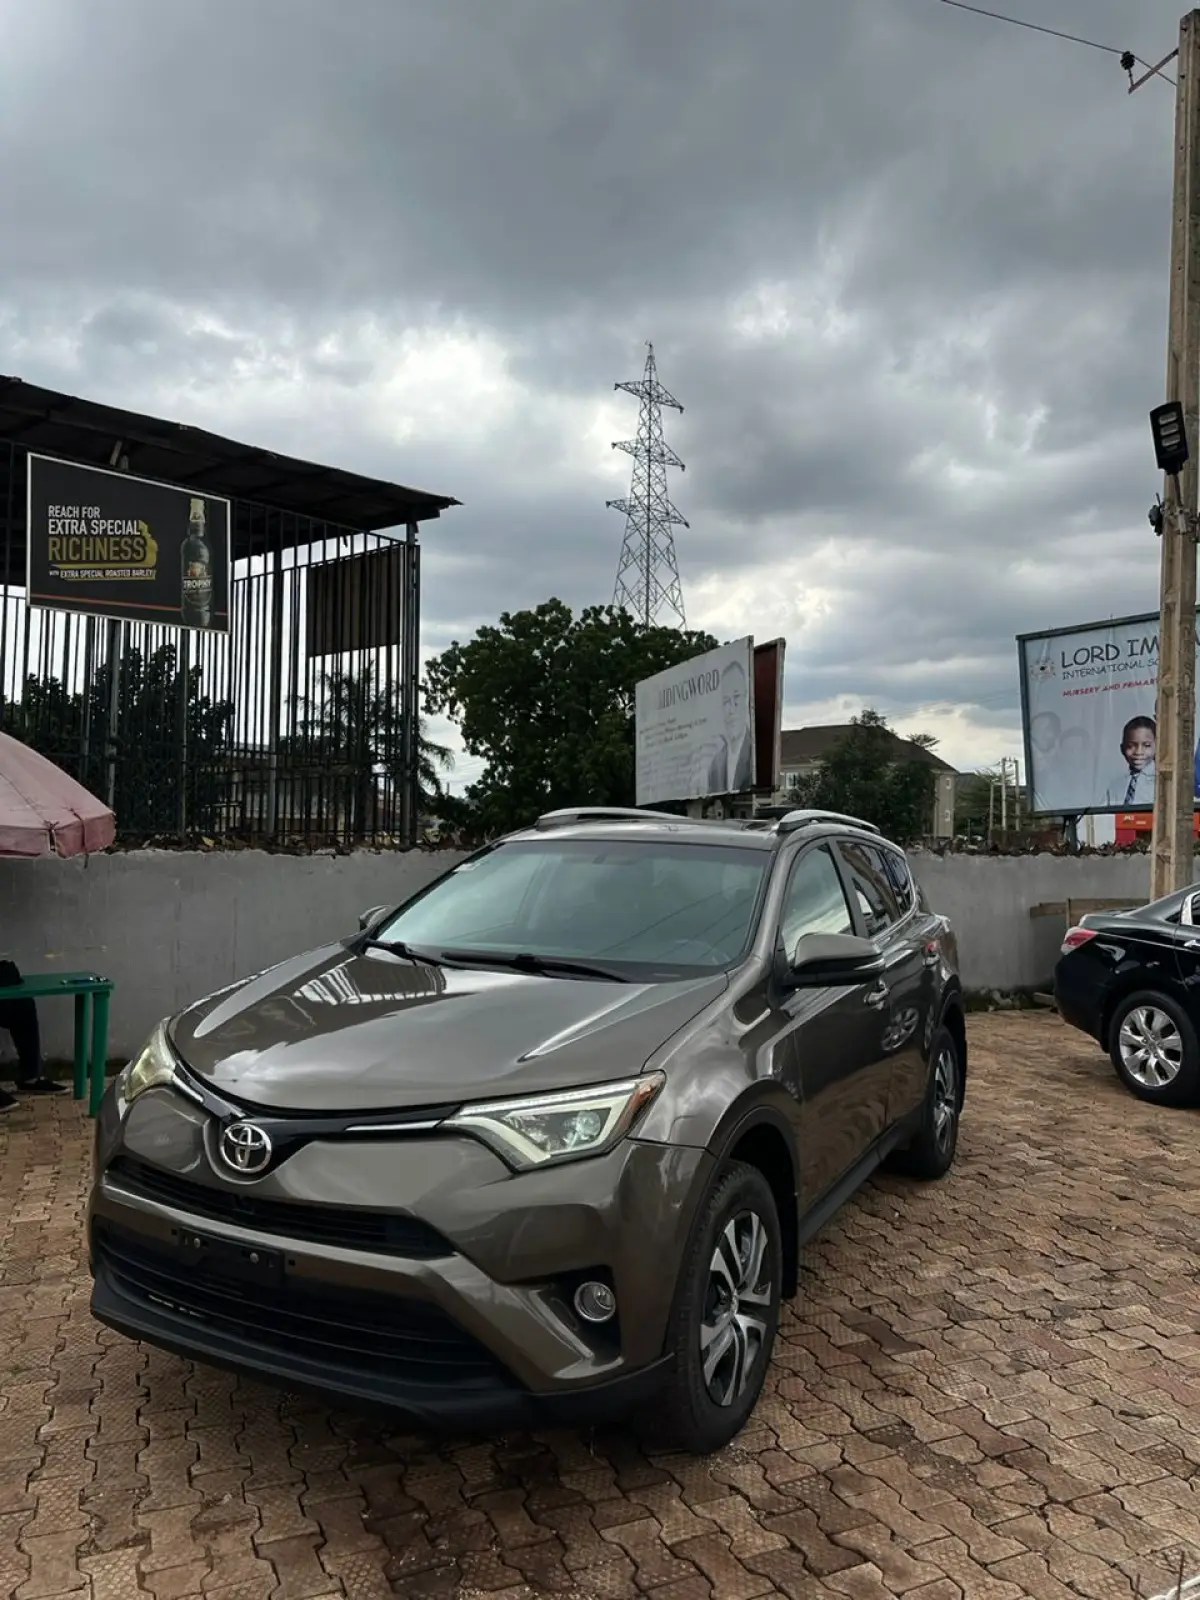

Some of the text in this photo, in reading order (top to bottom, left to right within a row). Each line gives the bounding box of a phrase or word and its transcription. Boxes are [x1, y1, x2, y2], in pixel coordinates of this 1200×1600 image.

[48, 505, 100, 519] REACH FOR
[48, 519, 140, 535] EXTRA SPECIAL
[48, 537, 145, 561] RICHNESS
[60, 569, 79, 578] EXTRA
[80, 569, 104, 578] SPECIAL
[1061, 635, 1160, 668] LORD IM
[1062, 660, 1144, 680] INTERNATIONAL
[656, 669, 720, 711] IDINGWORD
[1062, 686, 1100, 697] NURSERY
[1102, 683, 1121, 692] AND
